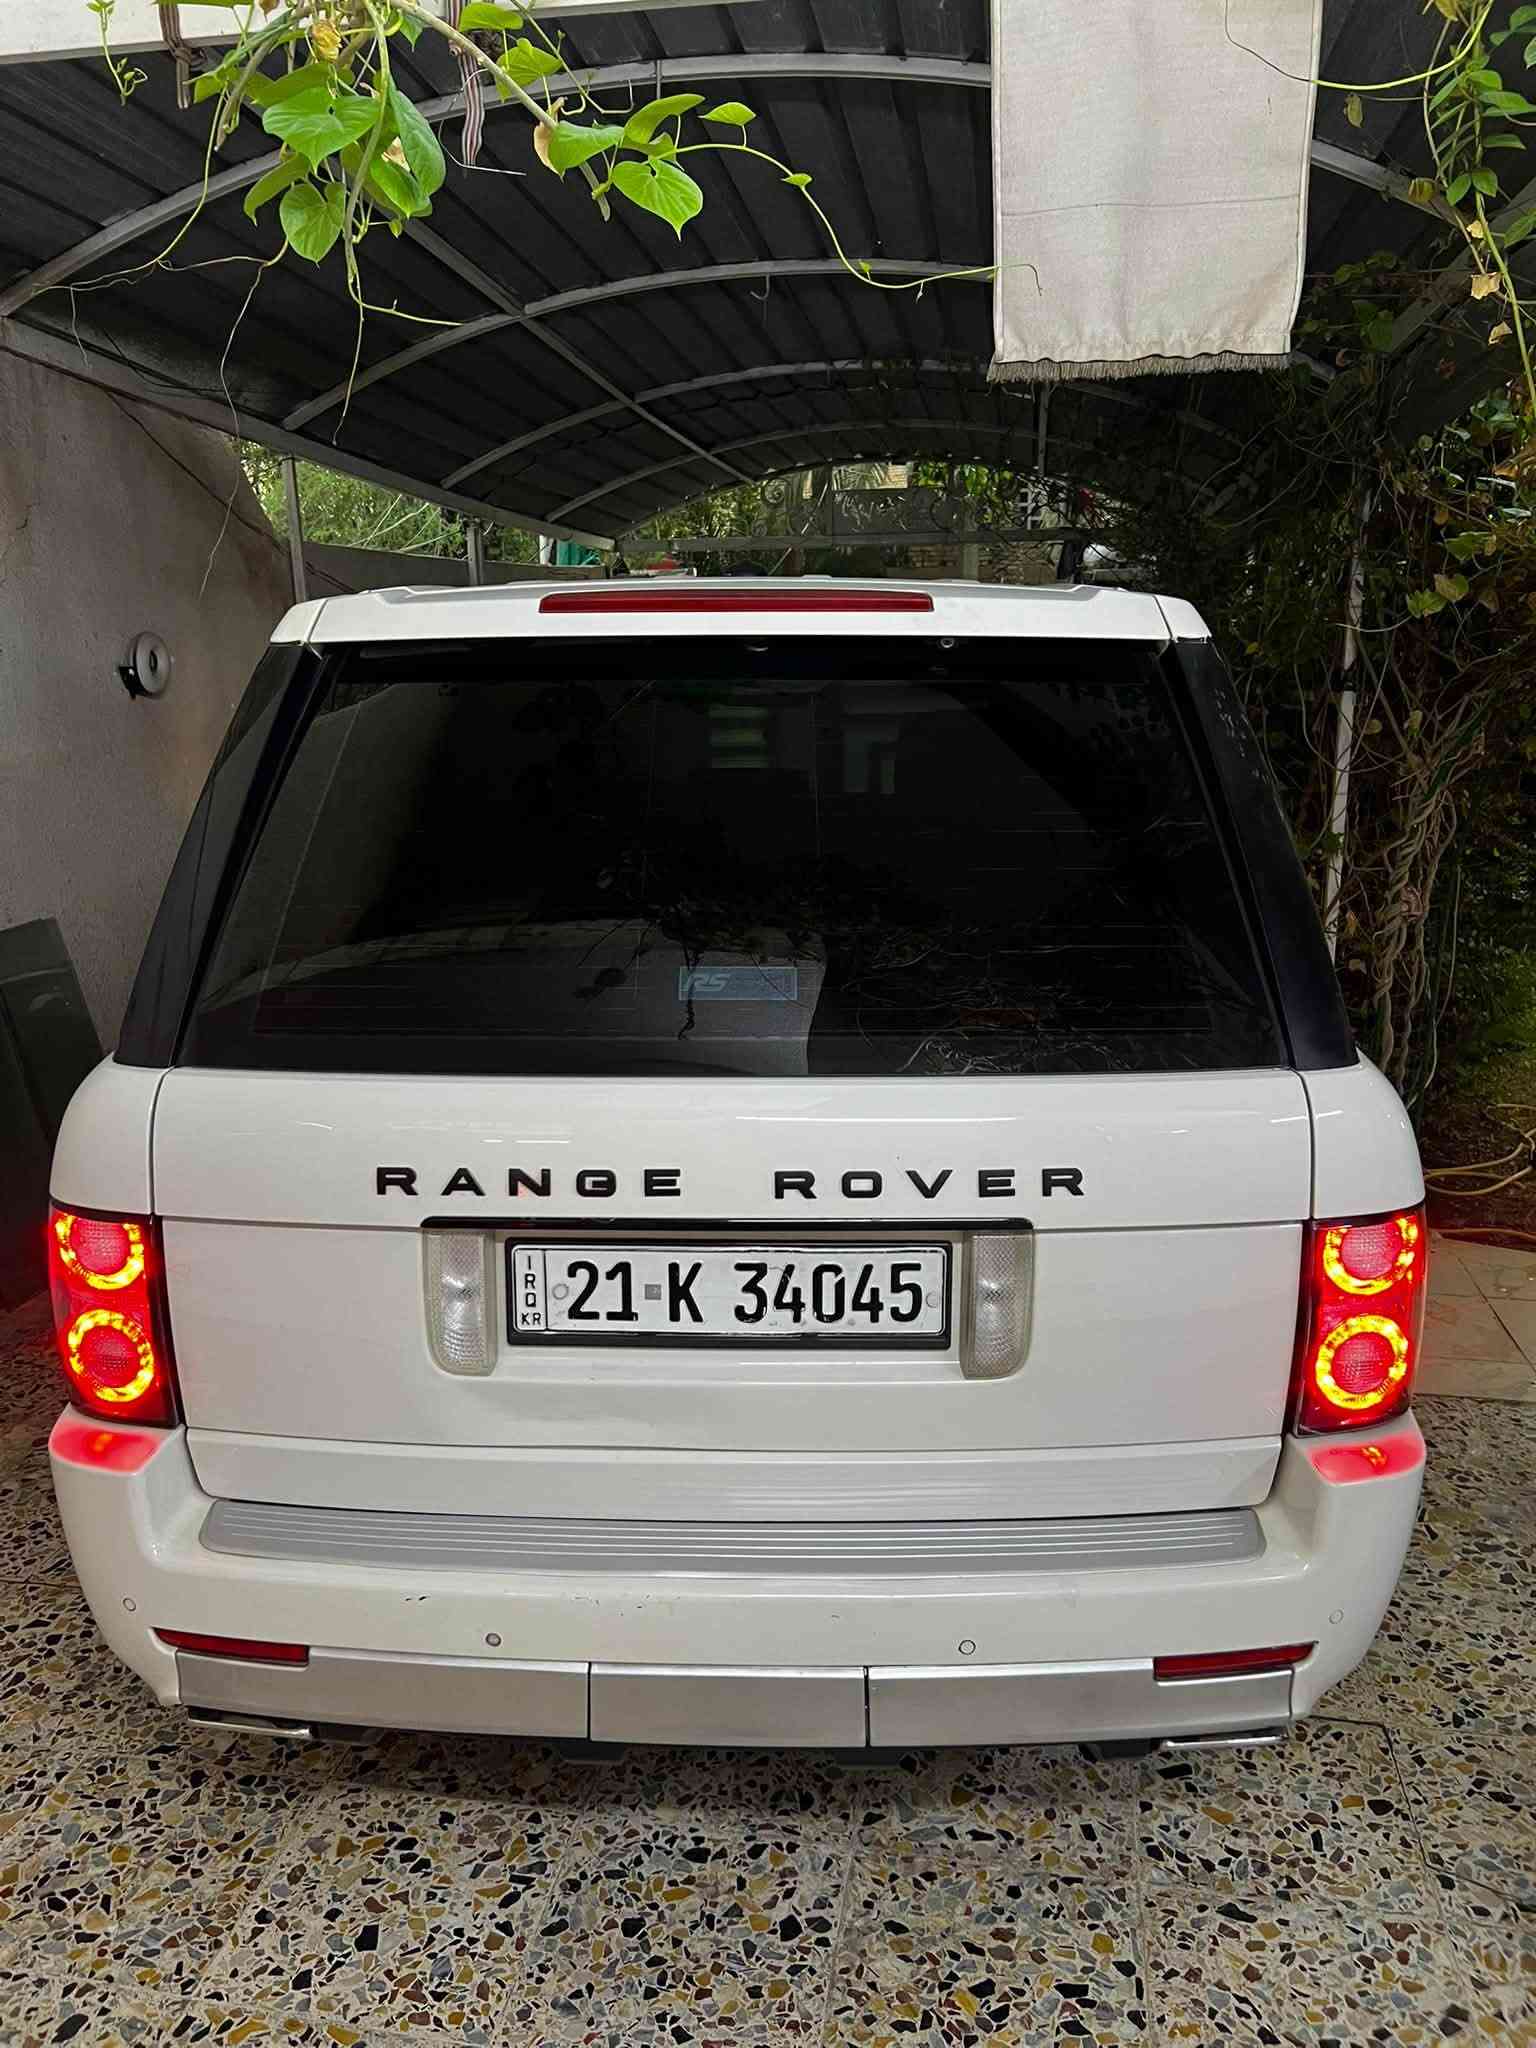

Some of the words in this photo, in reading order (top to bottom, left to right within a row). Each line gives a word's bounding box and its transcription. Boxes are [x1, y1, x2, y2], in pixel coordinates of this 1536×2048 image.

[376, 1166, 682, 1199] RANGE
[774, 1167, 1085, 1200] ROVER
[524, 1255, 538, 1308] IRQ
[567, 1260, 639, 1322] 21
[668, 1261, 704, 1323] K
[733, 1261, 924, 1324] 34045
[521, 1312, 542, 1326] KR
